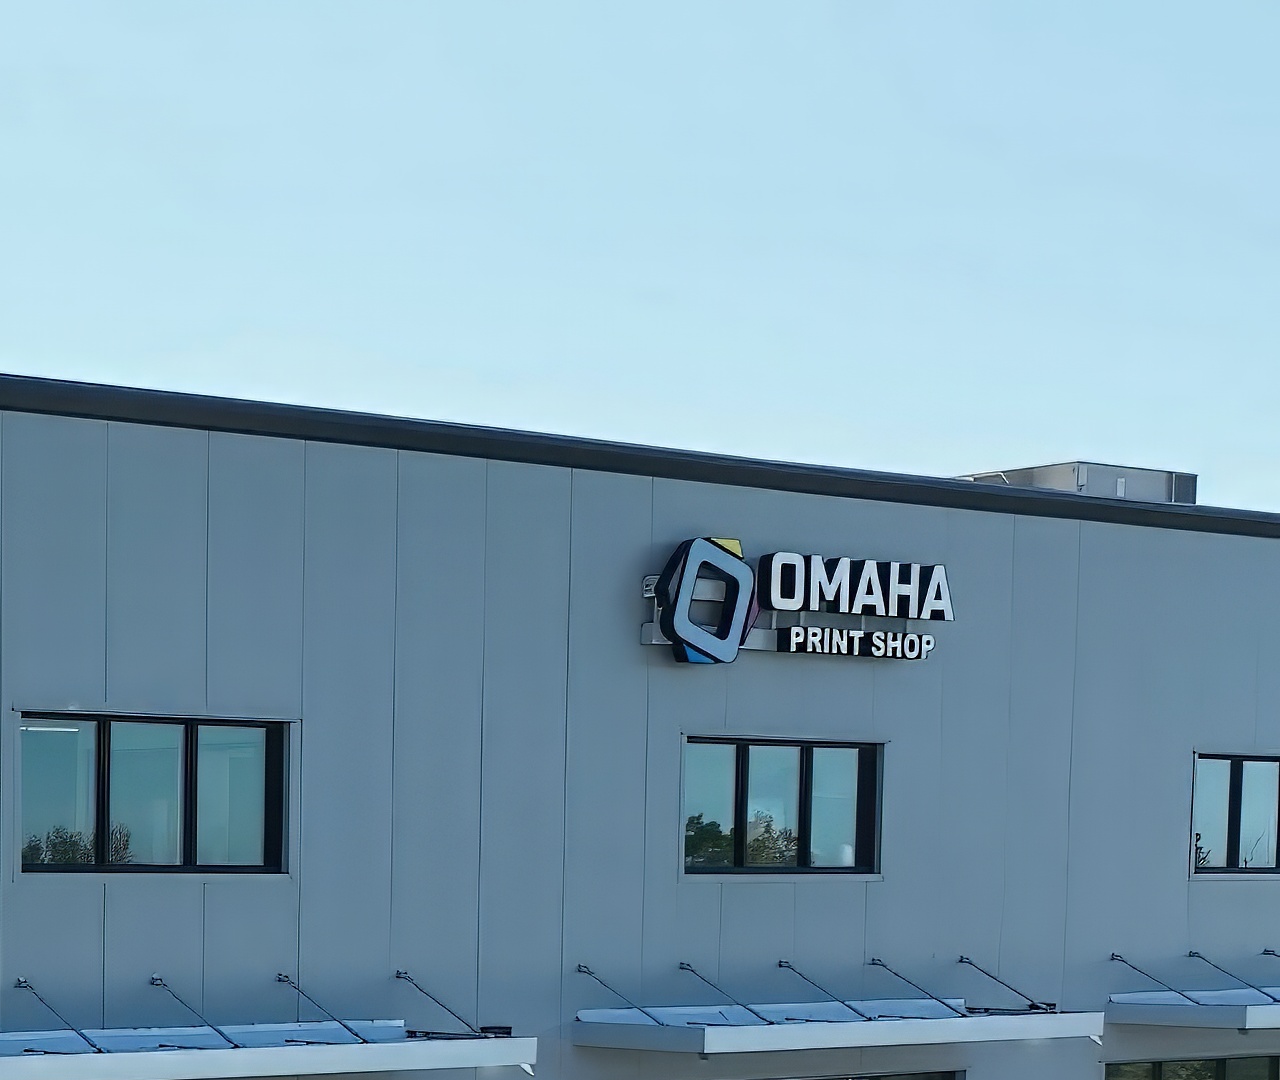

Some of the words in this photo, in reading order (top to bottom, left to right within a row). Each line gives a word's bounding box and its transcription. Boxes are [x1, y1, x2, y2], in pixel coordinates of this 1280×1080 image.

[766, 551, 955, 621] OMAHA
[789, 626, 864, 655] PRINT
[871, 631, 936, 660] SHOP
